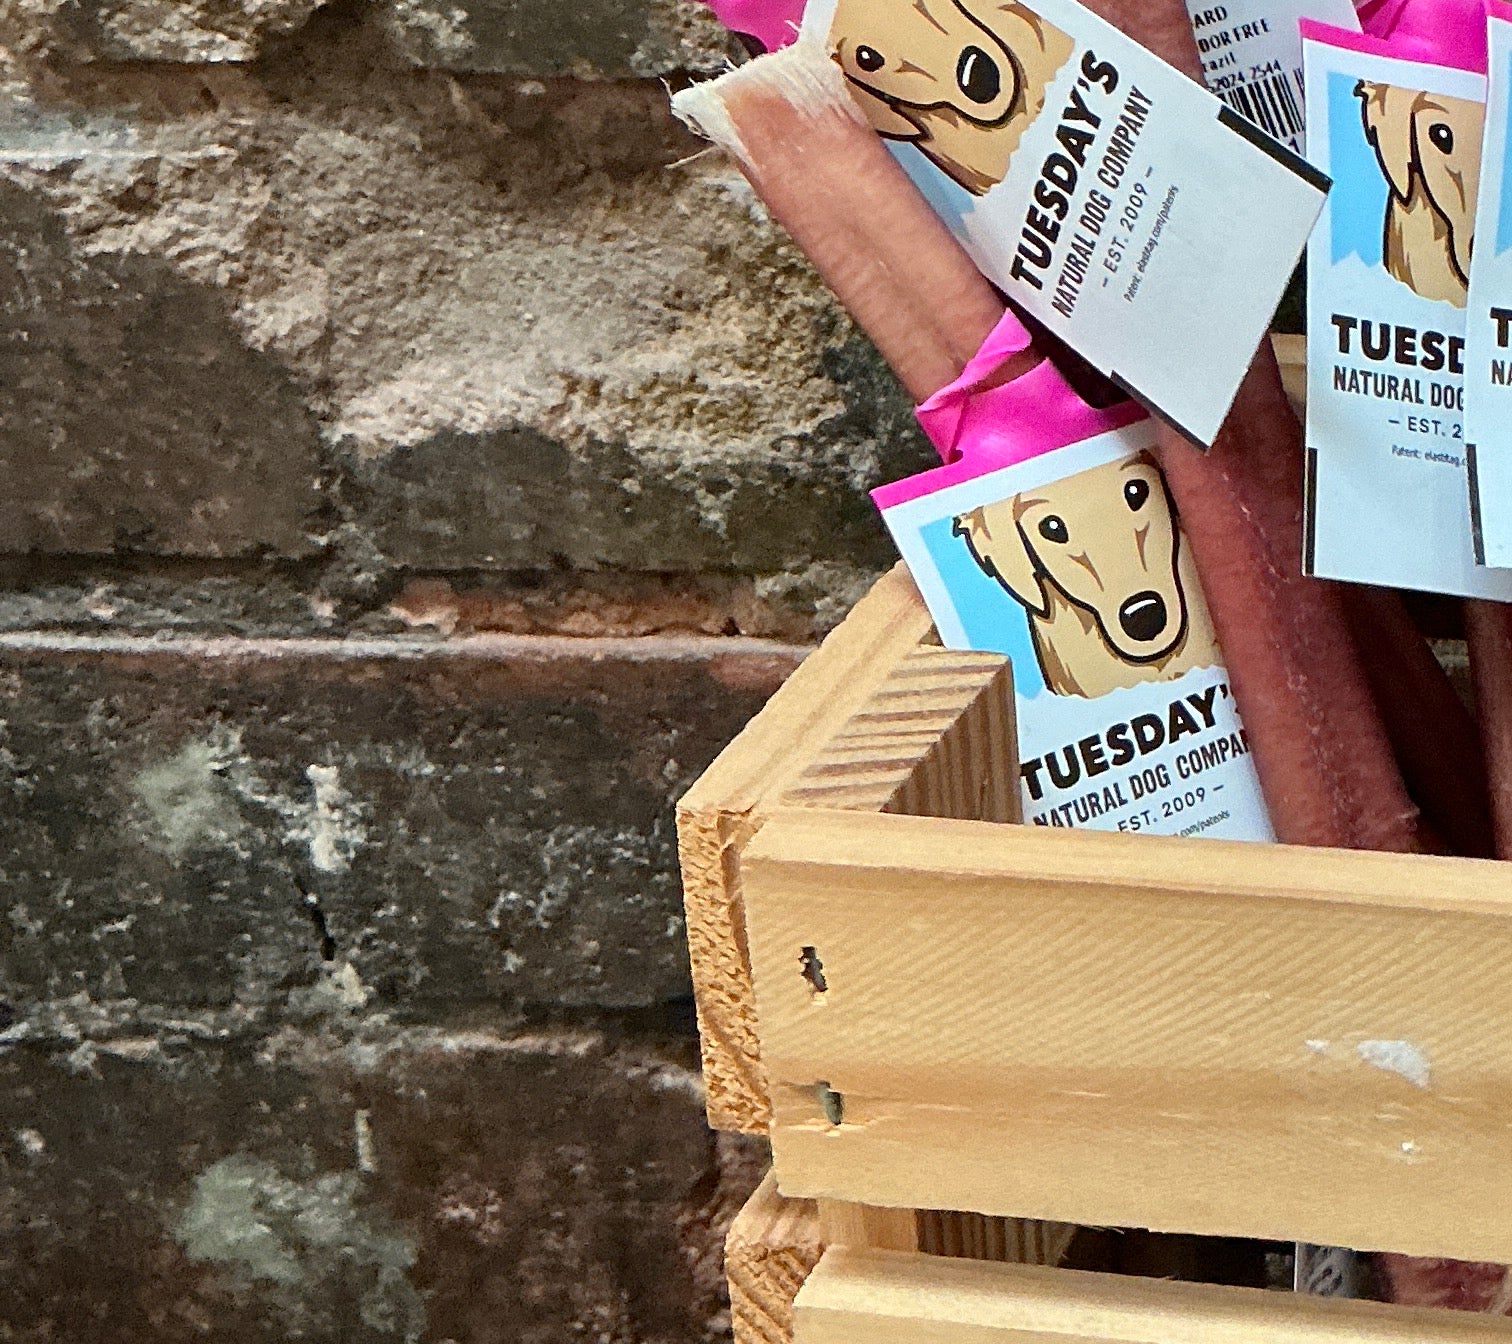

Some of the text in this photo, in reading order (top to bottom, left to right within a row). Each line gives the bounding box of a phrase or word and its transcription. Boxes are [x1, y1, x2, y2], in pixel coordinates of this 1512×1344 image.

[1192, 6, 1228, 29] ARD
[1009, 50, 1120, 291] TUESDAY'S
[1051, 85, 1153, 318] NATURAL DOG COMPANY
[1102, 182, 1148, 274] EST. 2009
[1333, 365, 1424, 405] NATURAL
[1408, 416, 1446, 437] EST.
[1020, 684, 1236, 801] TUESDAY'
[1128, 763, 1171, 800] DOG
[1117, 787, 1206, 832] EST. 2009
